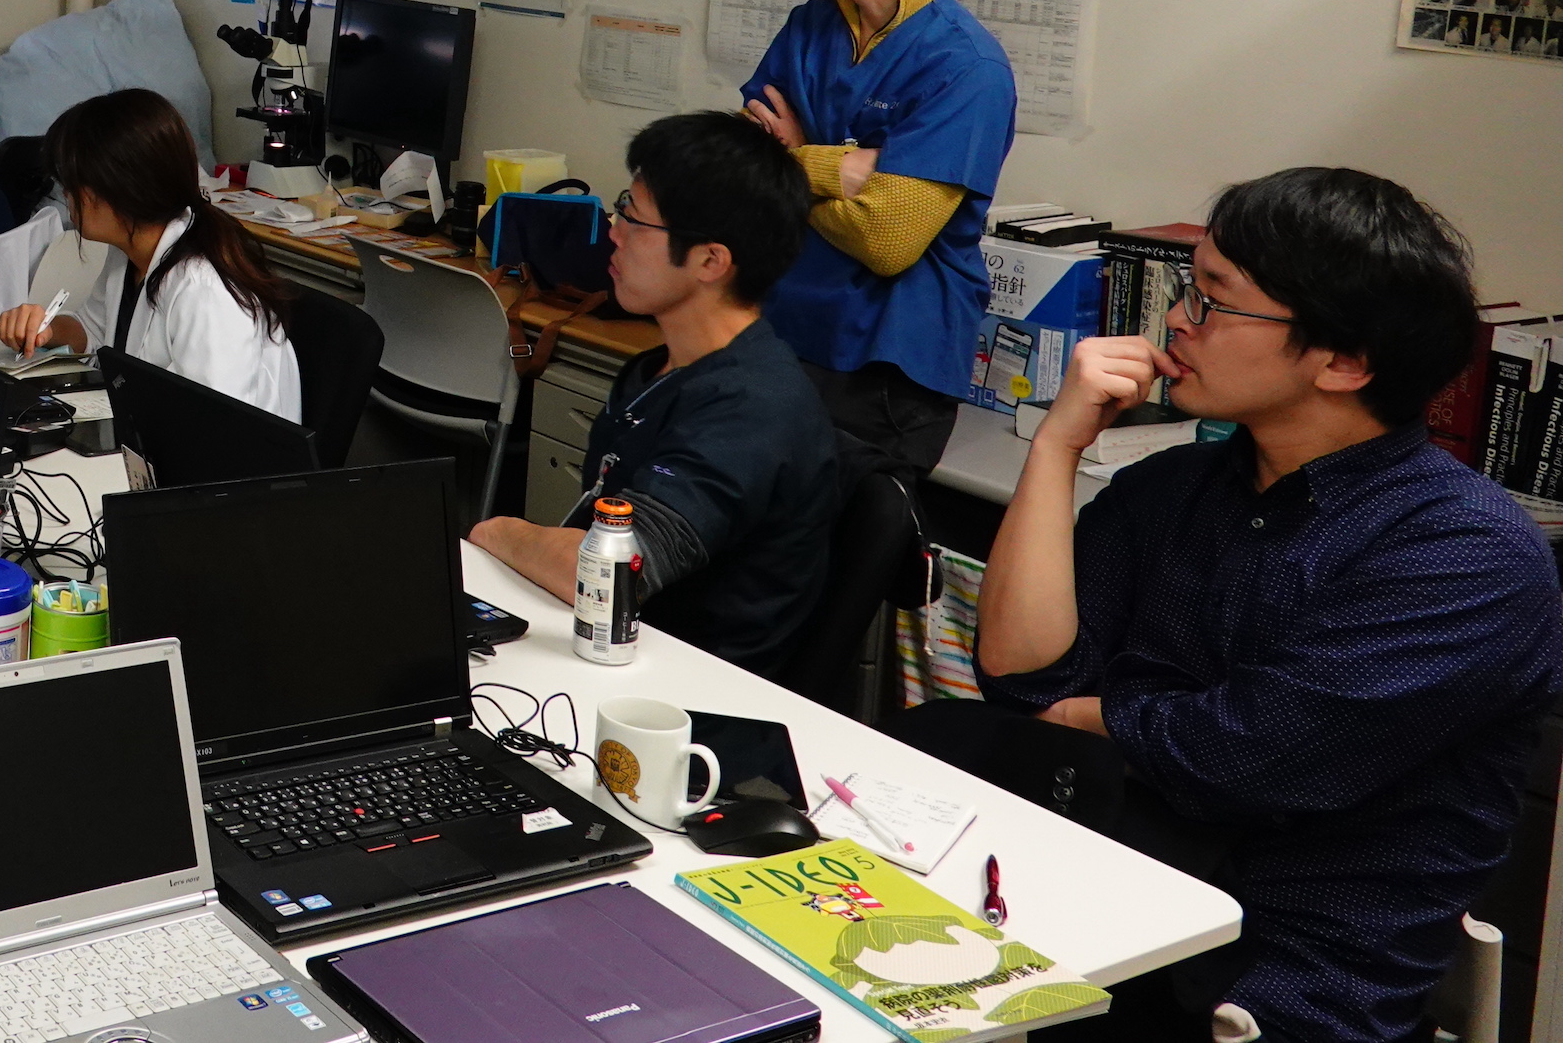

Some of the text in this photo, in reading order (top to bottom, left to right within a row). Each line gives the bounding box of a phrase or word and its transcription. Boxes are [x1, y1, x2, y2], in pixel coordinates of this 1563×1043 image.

[1013, 266, 1025, 275] 62
[1139, 265, 1155, 335] 臨床感染症学
[1442, 408, 1453, 426] OF
[1488, 384, 1506, 445] Infectious
[1503, 387, 1519, 432] Principles
[1541, 396, 1563, 458] Infectious
[1499, 433, 1510, 452] and
[856, 854, 876, 870] 5
[585, 1002, 641, 1022] Panasonic
[896, 1000, 962, 1021] 見直そう
